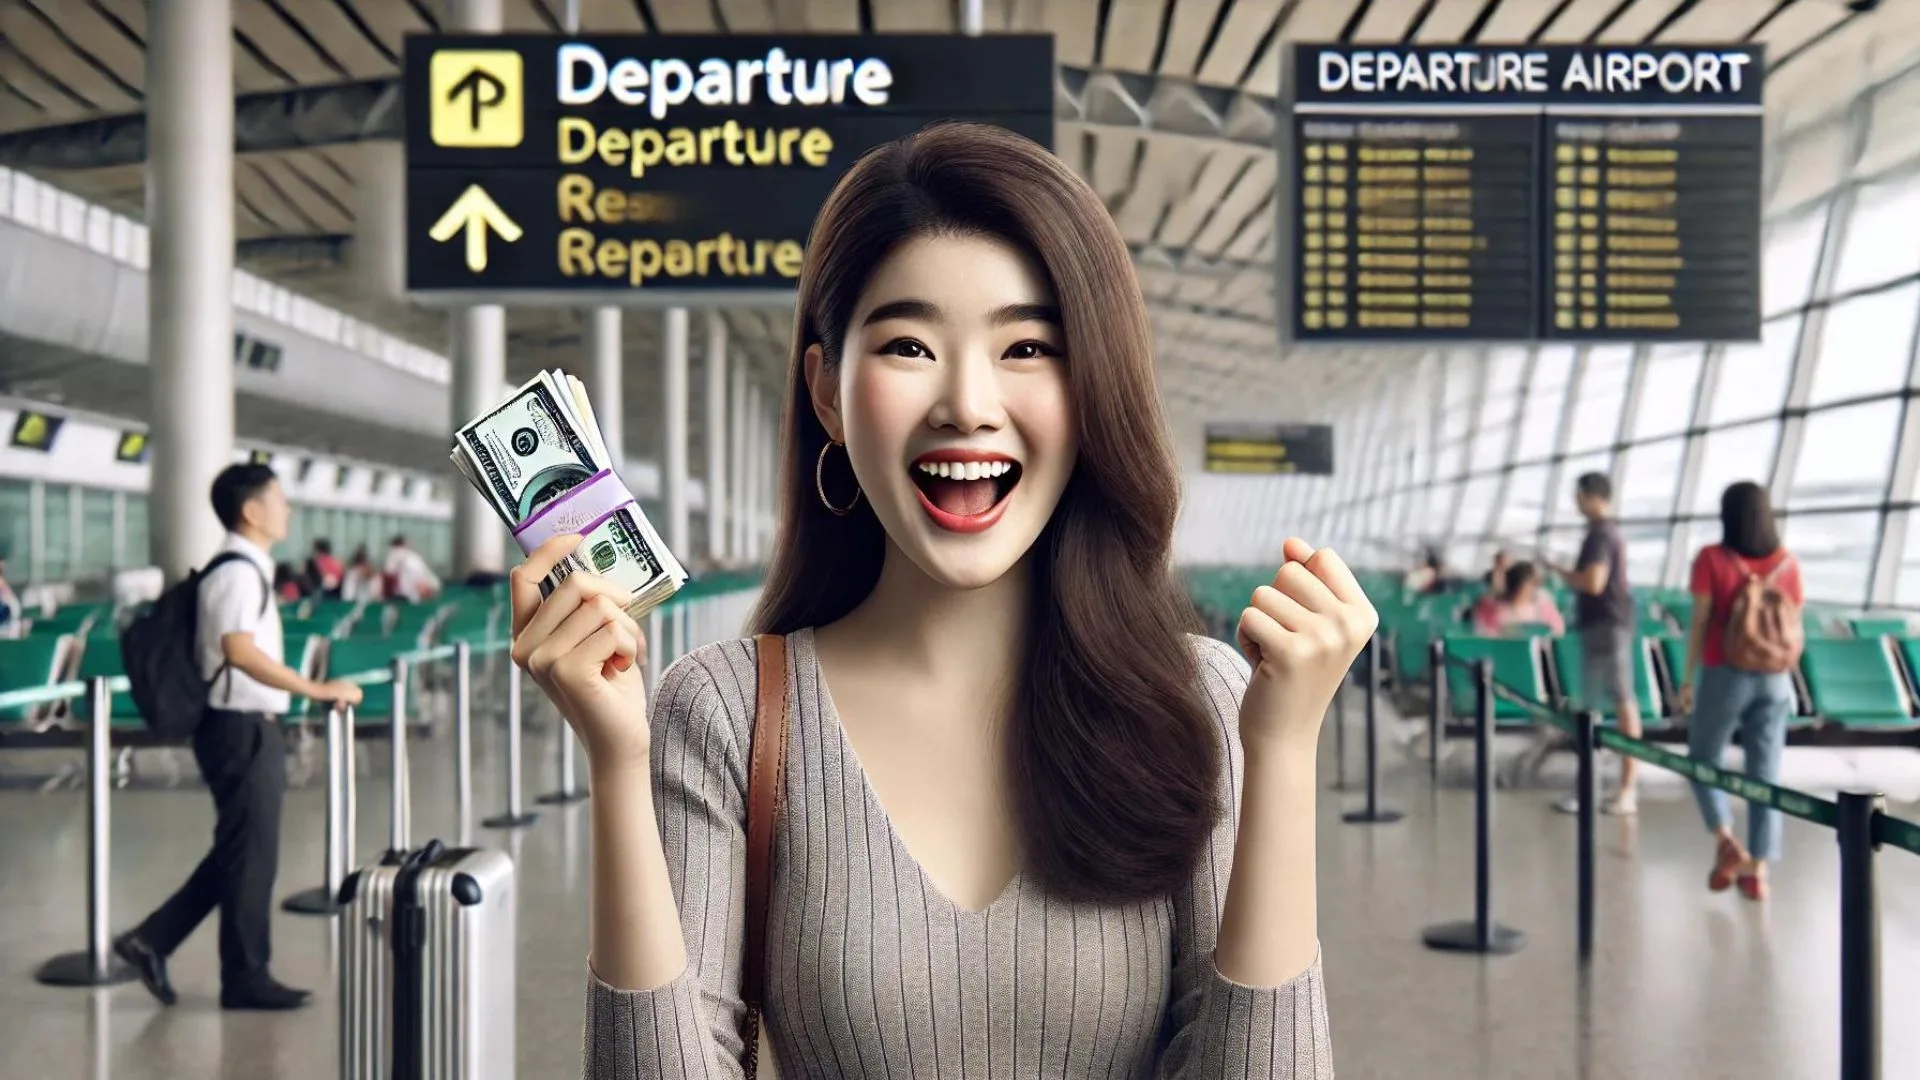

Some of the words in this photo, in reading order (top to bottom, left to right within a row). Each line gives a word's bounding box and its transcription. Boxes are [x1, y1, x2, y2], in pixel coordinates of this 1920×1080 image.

[556, 43, 893, 120] Departure
[1318, 51, 1548, 93] DEPARTURE
[1562, 51, 1753, 93] AIRPORT
[557, 117, 834, 178] Departure
